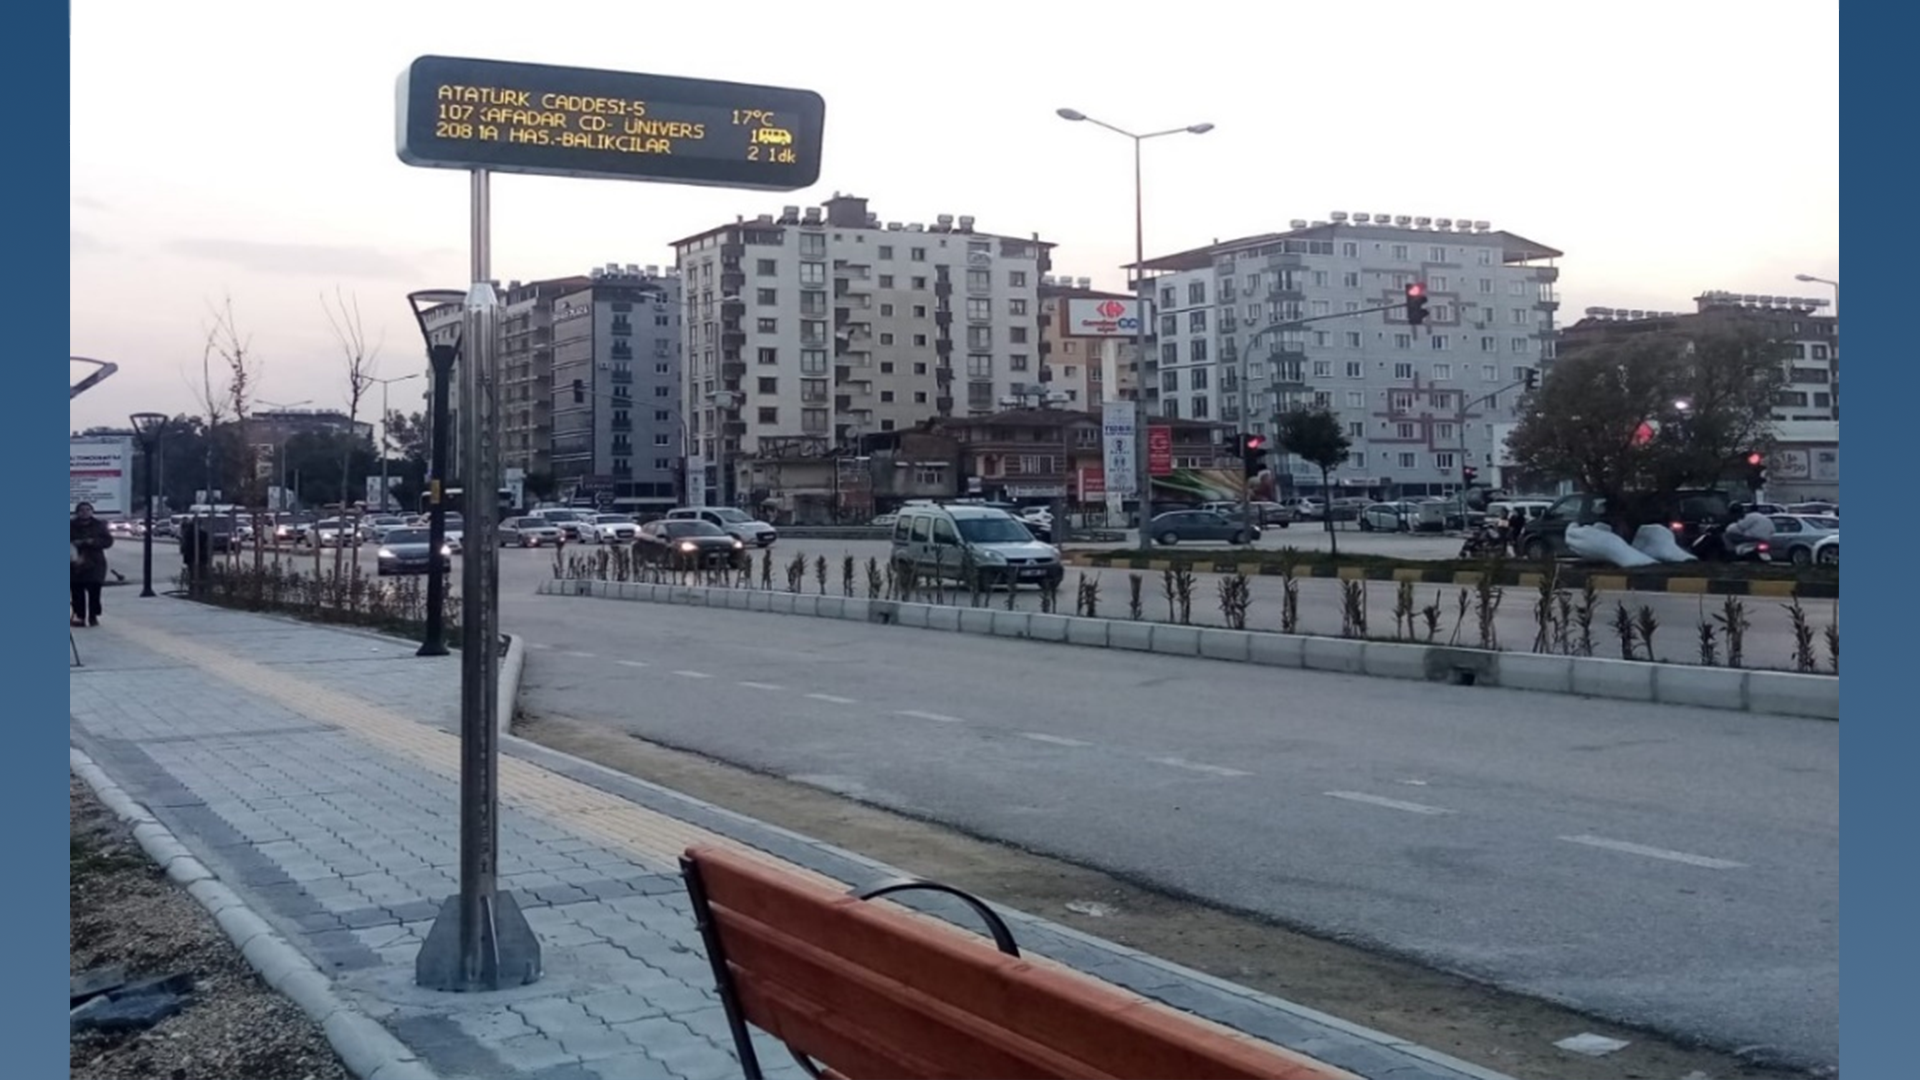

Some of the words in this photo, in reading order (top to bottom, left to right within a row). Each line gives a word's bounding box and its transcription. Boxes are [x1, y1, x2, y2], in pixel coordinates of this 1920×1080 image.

[438, 84, 530, 107] ATATÜRK
[439, 104, 473, 120] 107
[732, 109, 774, 127] 17°C
[436, 121, 473, 139] 208
[747, 145, 758, 162] 2
